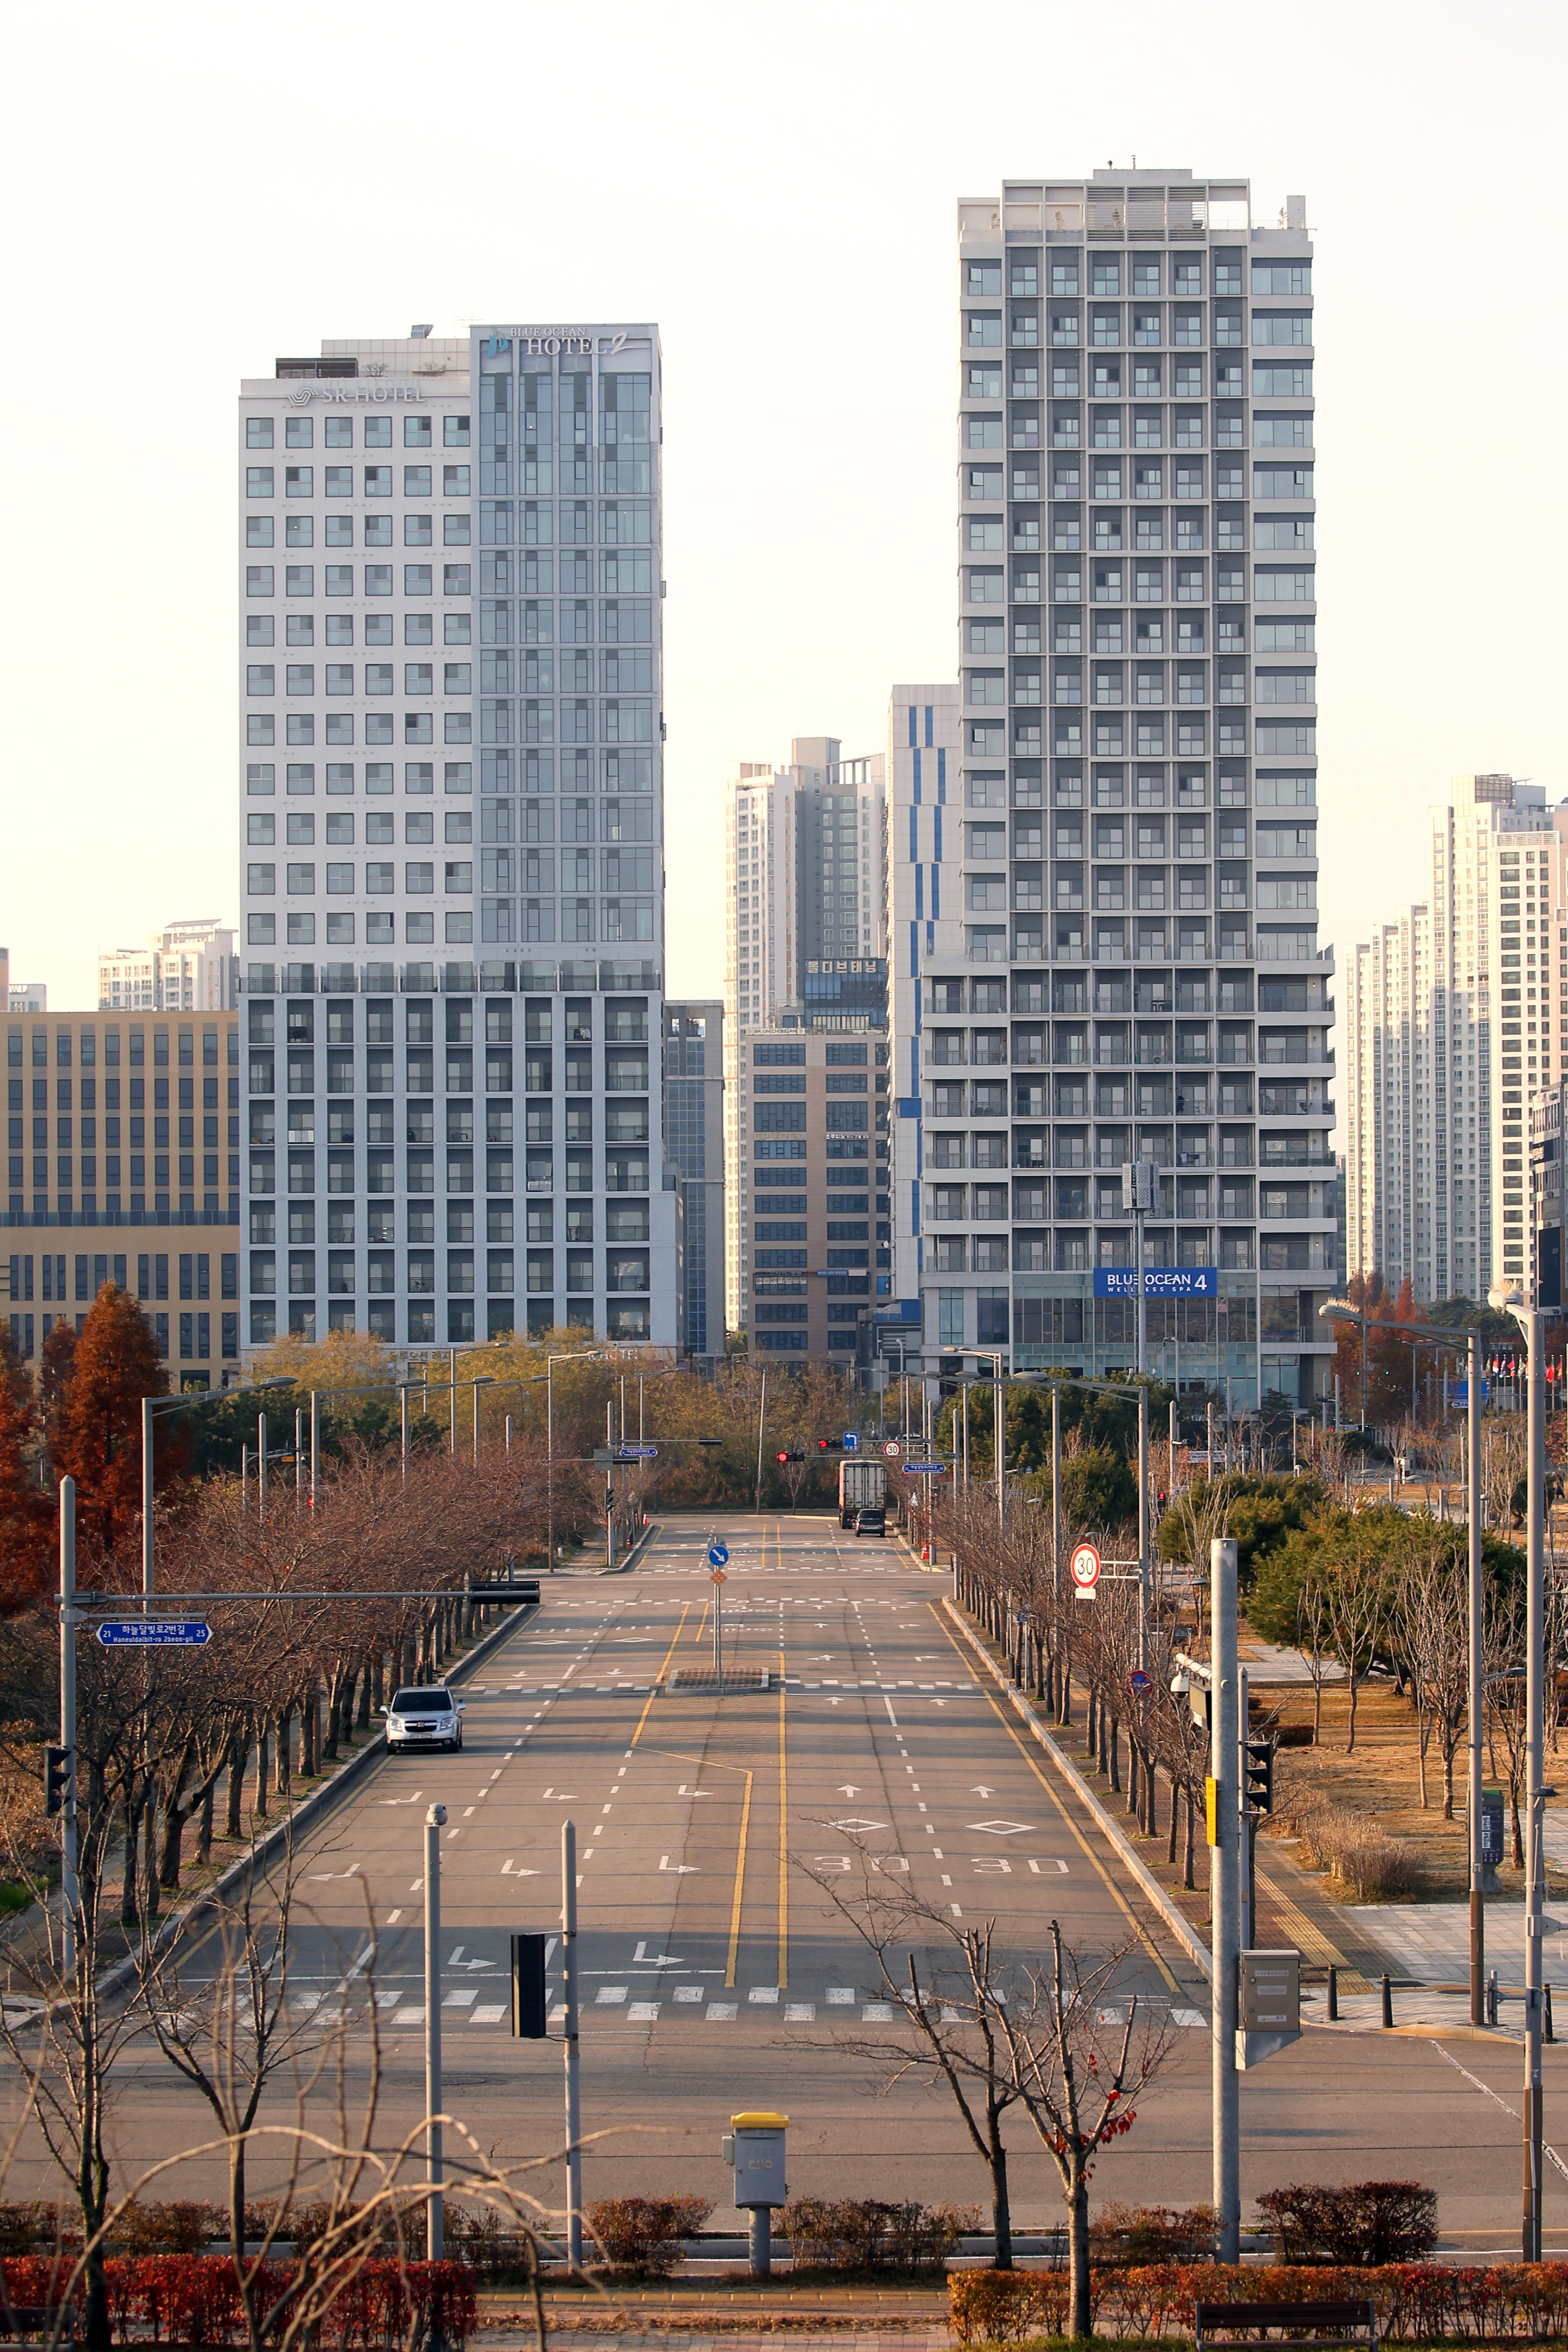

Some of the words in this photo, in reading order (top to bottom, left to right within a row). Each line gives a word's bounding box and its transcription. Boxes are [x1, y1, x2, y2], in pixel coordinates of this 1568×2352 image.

[510, 327, 541, 337] BLUE
[544, 327, 586, 337] OCEAN
[526, 338, 607, 355] HOTEL
[610, 331, 637, 355] 2
[323, 387, 348, 403] SR
[355, 387, 425, 403] HOTEL
[808, 960, 876, 974] 몰디브태닝
[1145, 1274, 1191, 1285] OCEAN
[1194, 1274, 1208, 1291] 4
[1077, 1557, 1094, 1575] 30
[122, 1625, 185, 1635] 하늘달빛로2번길
[814, 1856, 910, 1872] 30
[970, 1858, 1070, 1874] 30
